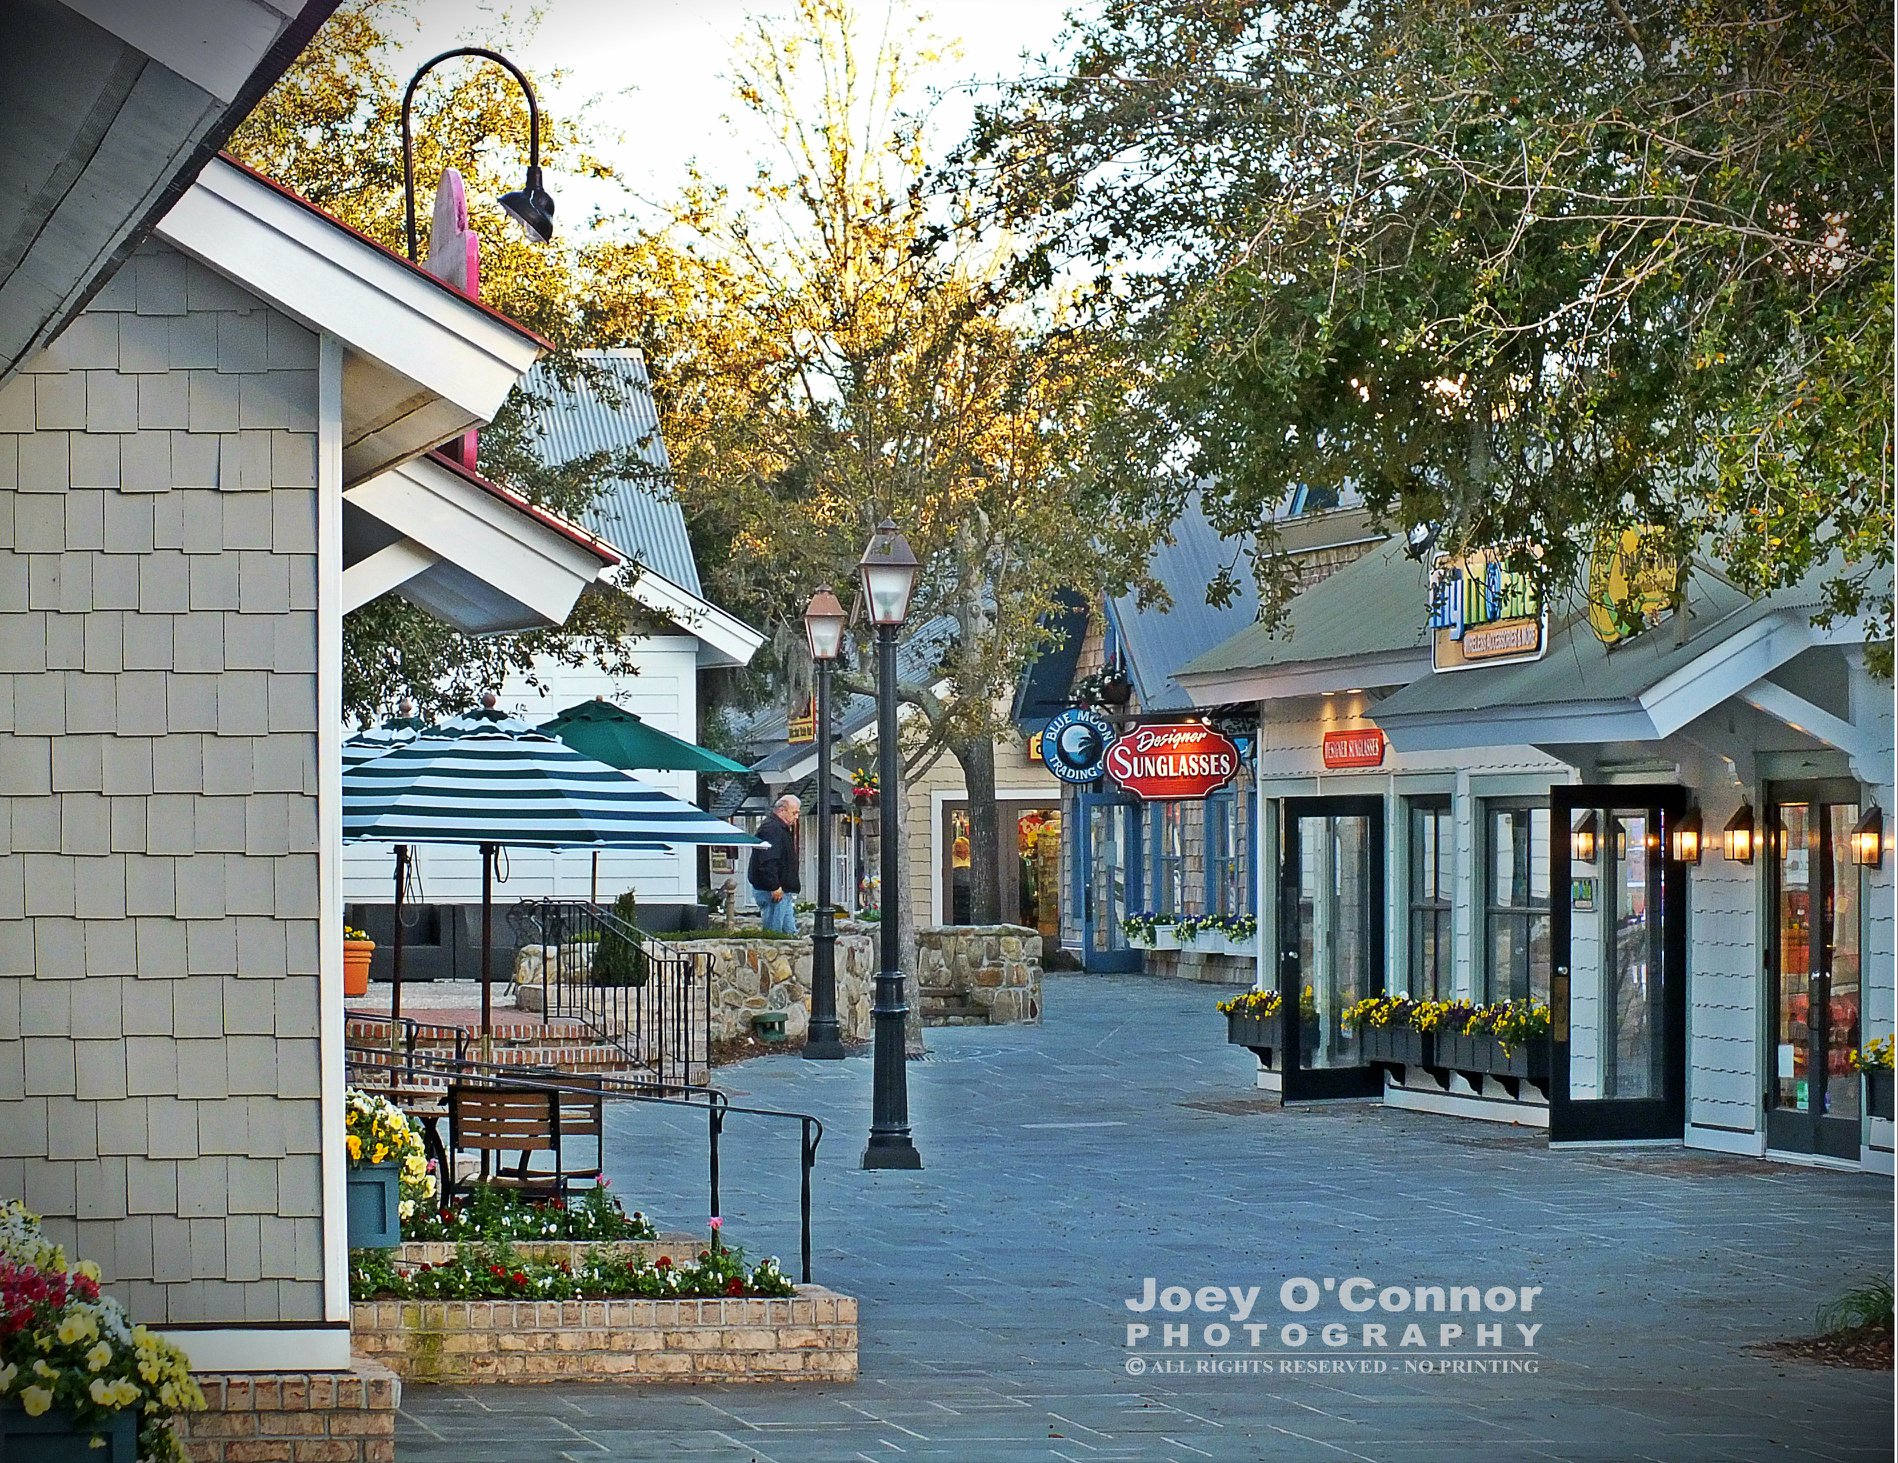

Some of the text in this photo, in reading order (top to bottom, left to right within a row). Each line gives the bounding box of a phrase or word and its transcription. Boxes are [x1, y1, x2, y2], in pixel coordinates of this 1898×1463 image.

[1045, 710, 1113, 741] BLUE MOON
[1136, 729, 1207, 752] Designer
[1348, 738, 1378, 758] SUNGLASSES
[1049, 754, 1098, 779] TRADING
[1114, 746, 1230, 779] SUNGLASSES
